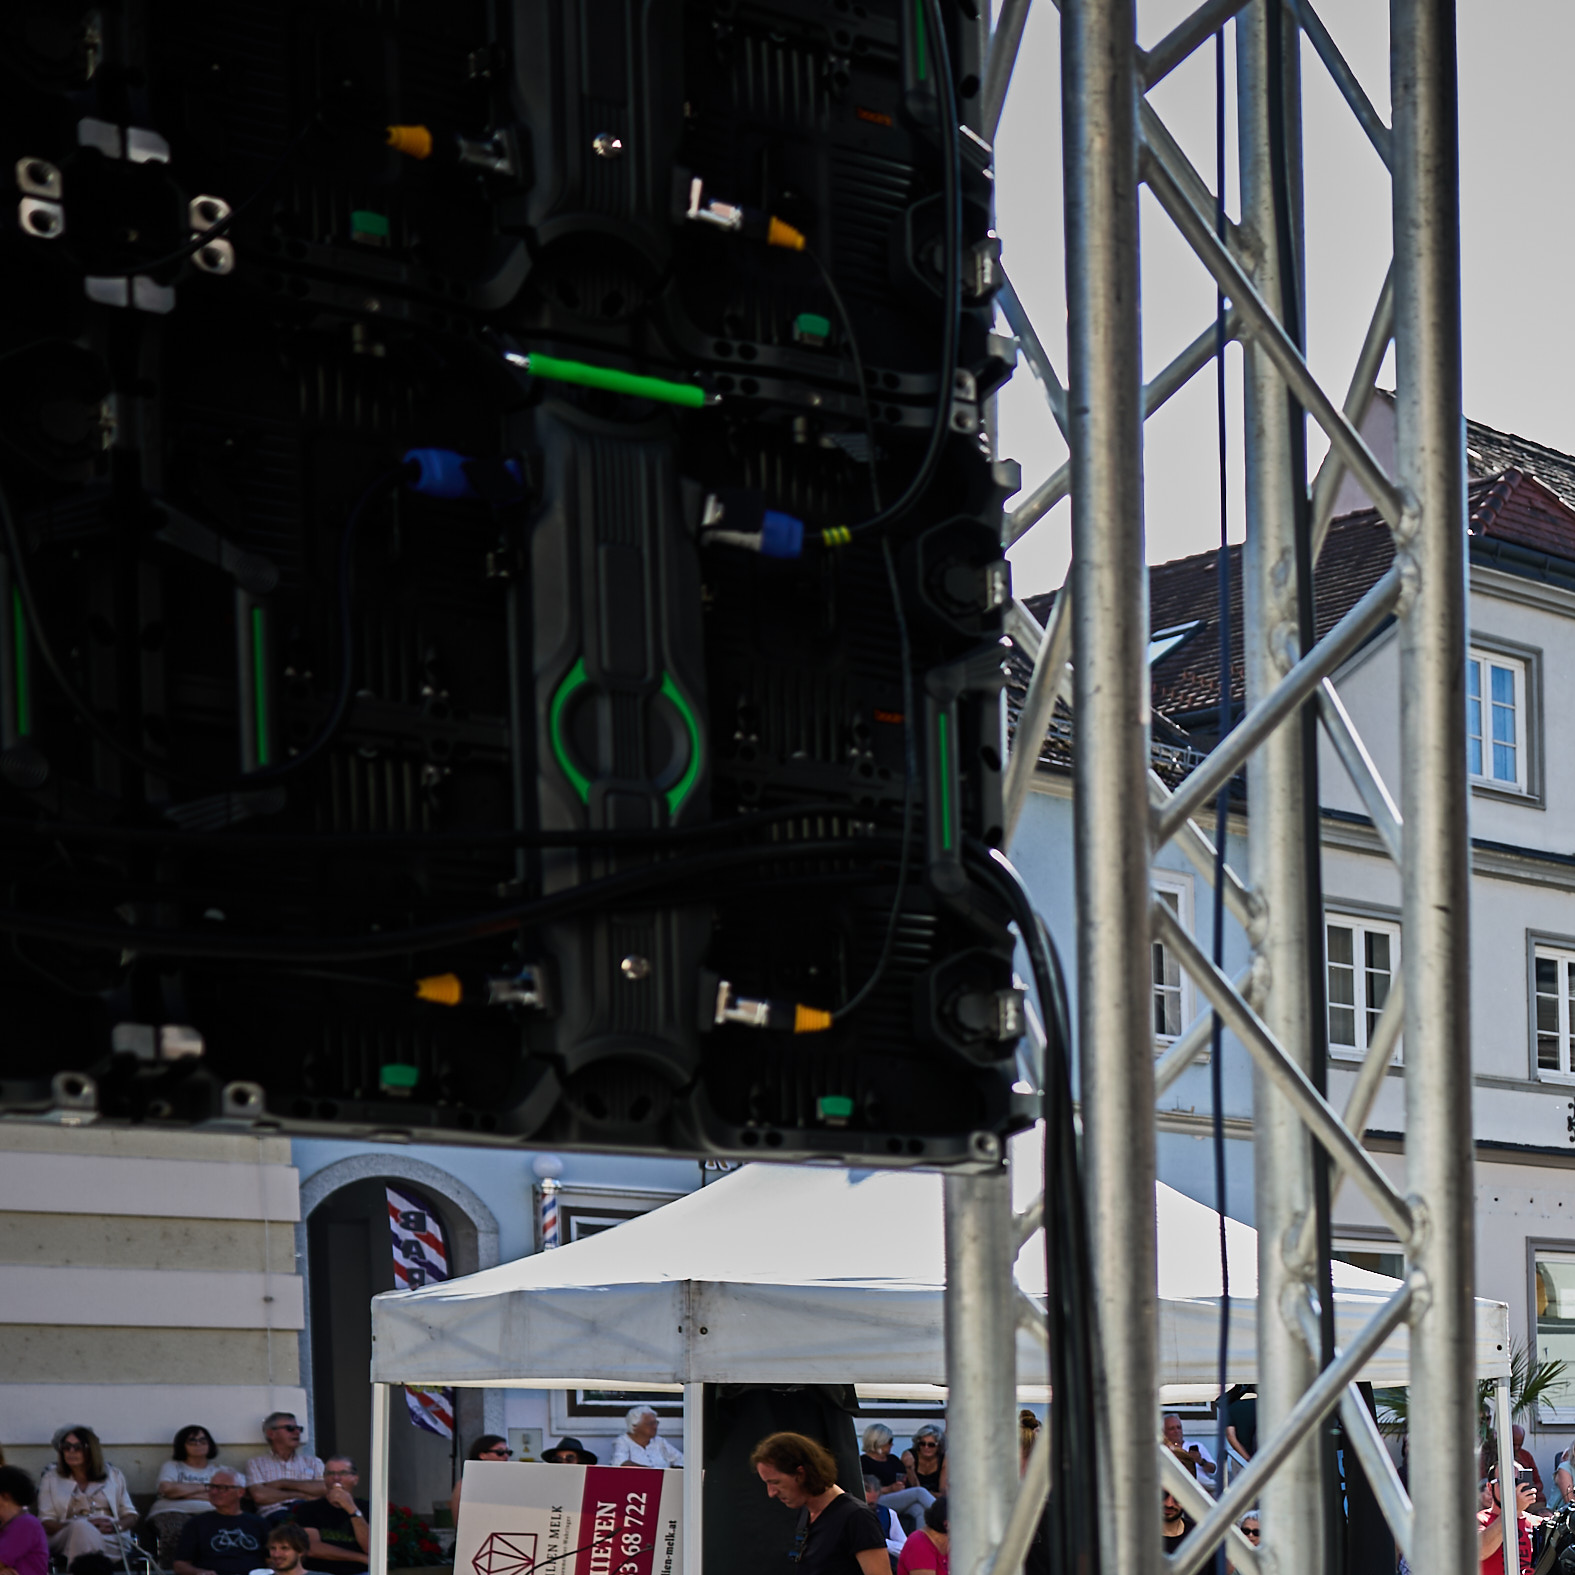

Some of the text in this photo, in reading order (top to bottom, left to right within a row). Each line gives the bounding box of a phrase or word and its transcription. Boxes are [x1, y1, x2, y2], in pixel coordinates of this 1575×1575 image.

[549, 1505, 563, 1539] MELK
[624, 1492, 647, 1527] 722
[621, 1533, 642, 1556] 68
